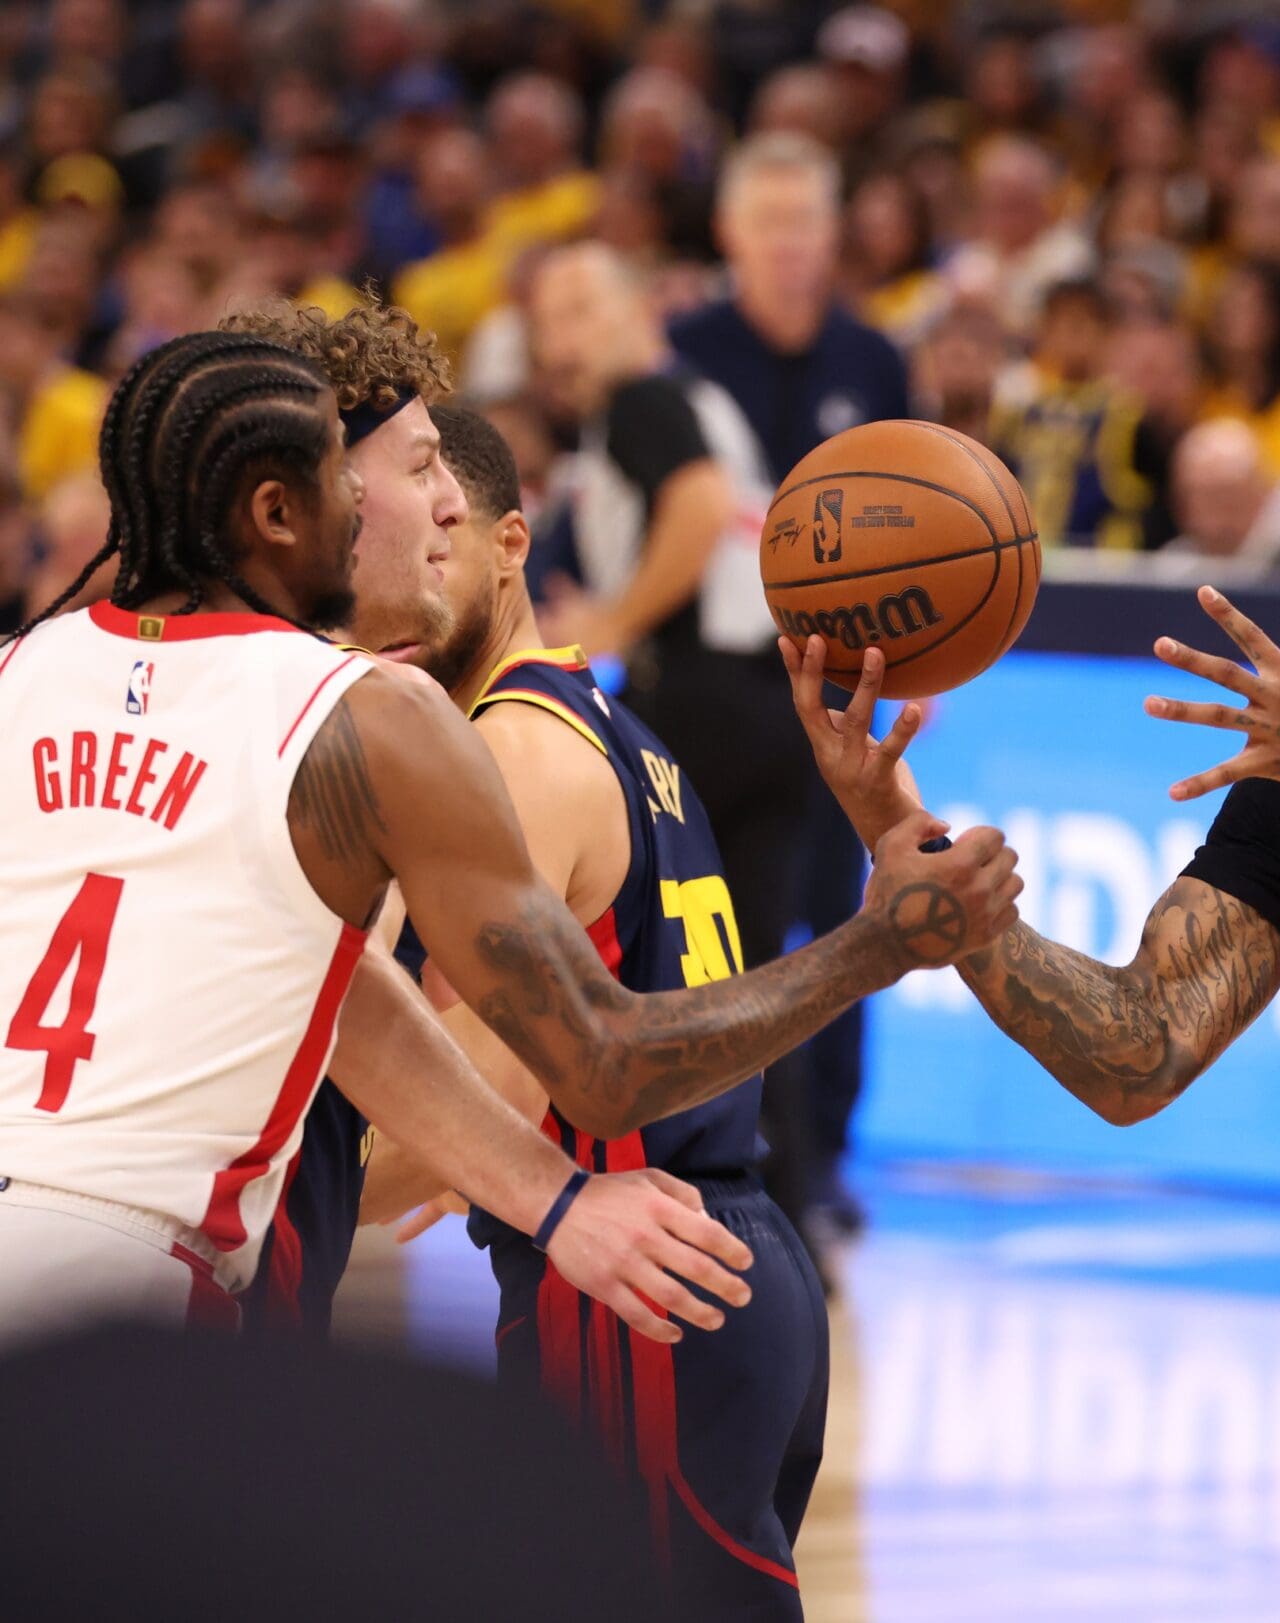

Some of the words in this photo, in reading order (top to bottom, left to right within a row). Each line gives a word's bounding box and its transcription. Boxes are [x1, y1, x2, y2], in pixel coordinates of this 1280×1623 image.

[771, 585, 944, 649] Wilson
[33, 731, 207, 831] GREEN
[5, 872, 125, 1112] 4
